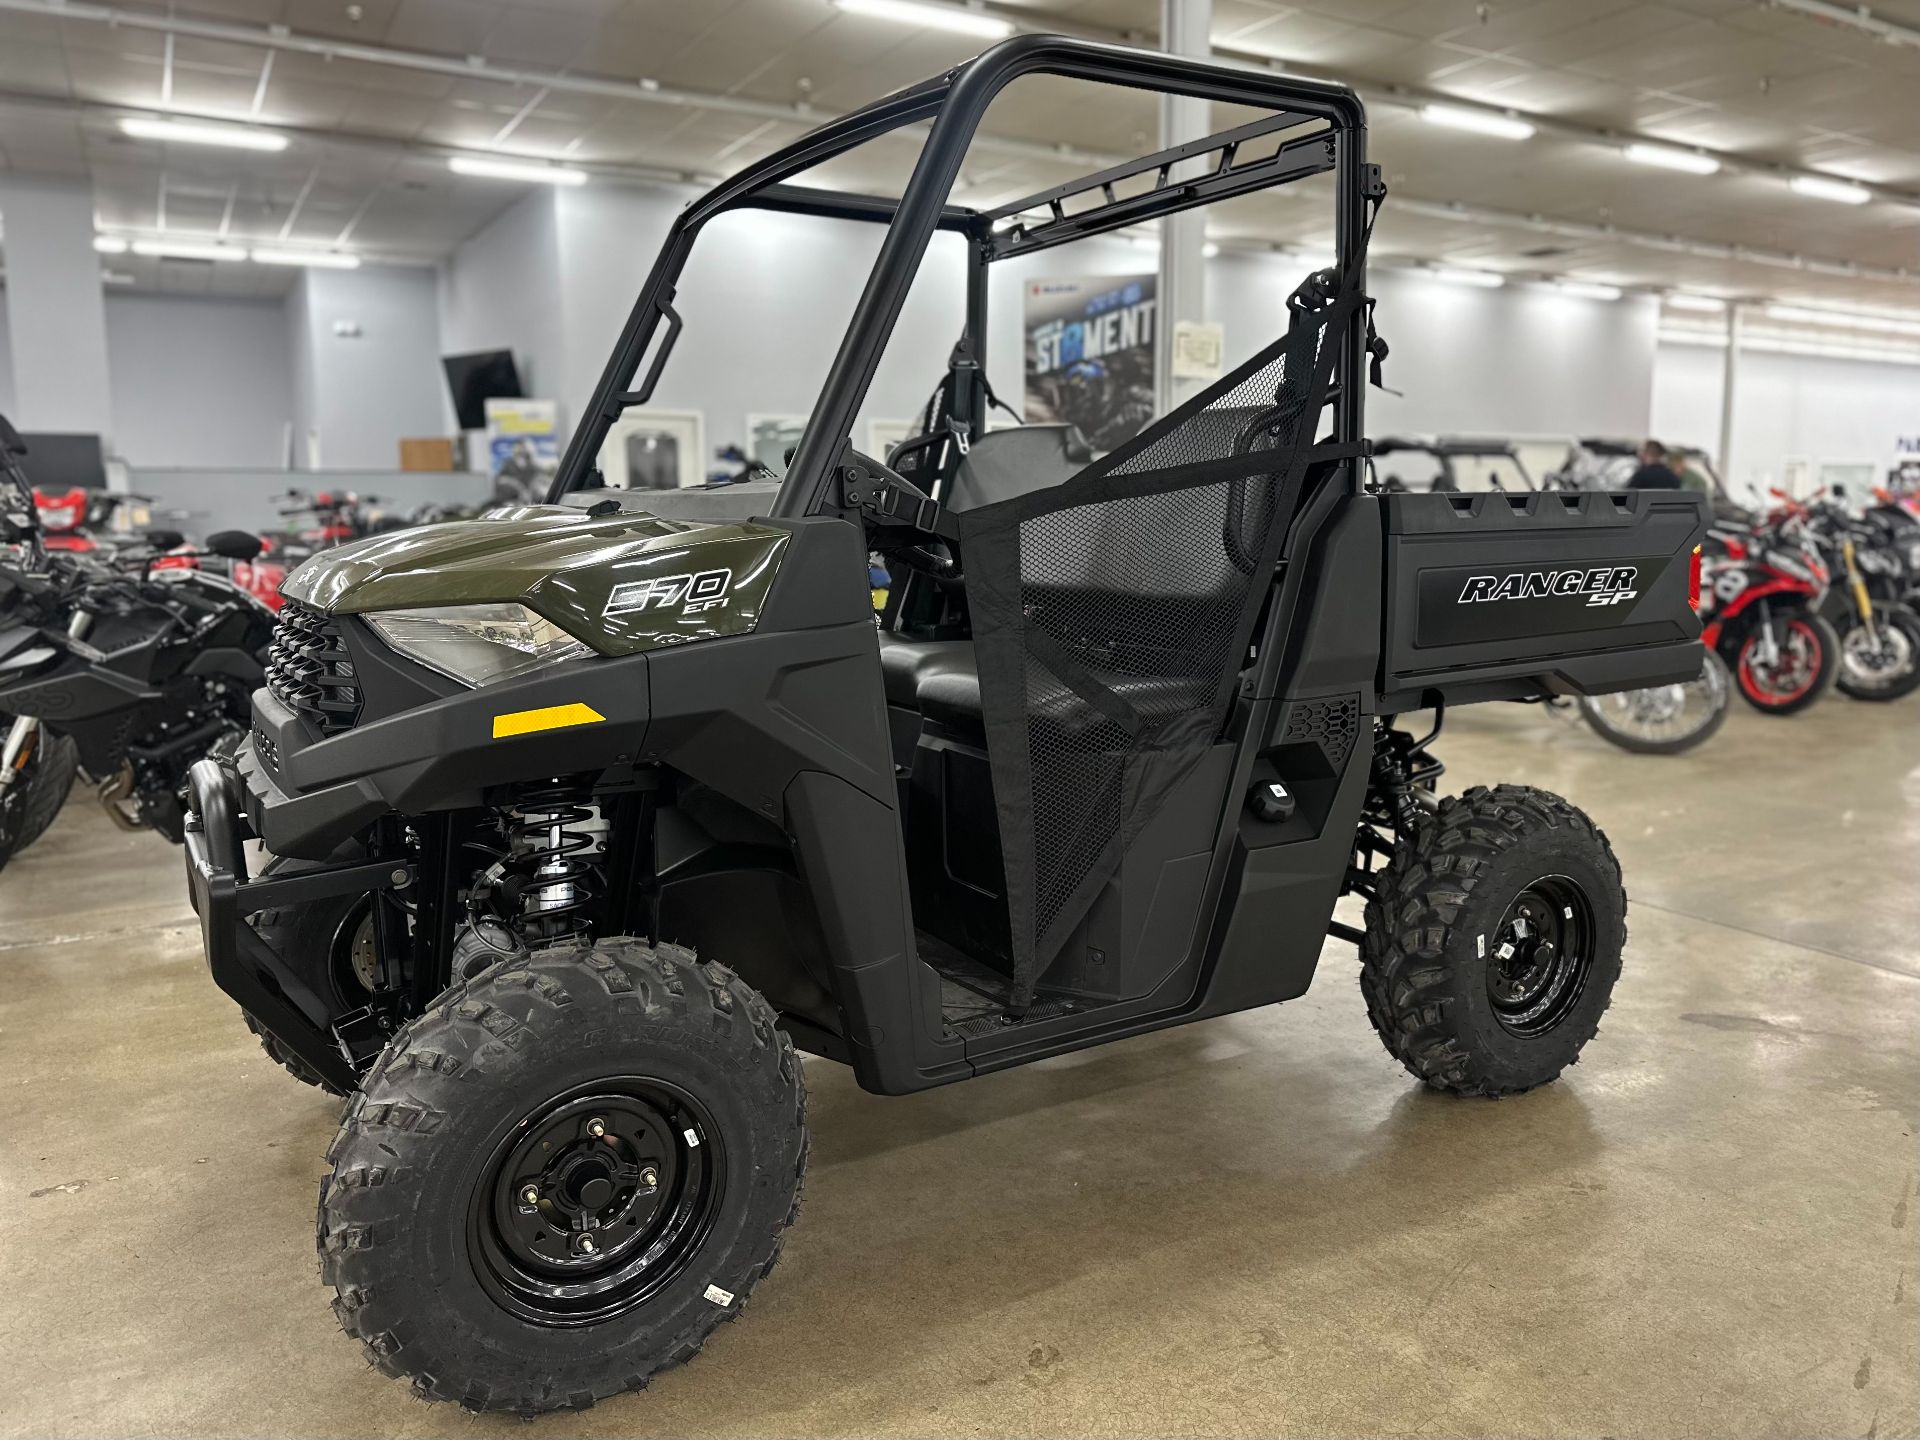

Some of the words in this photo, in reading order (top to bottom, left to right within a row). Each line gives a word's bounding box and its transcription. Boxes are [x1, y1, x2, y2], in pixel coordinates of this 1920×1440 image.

[601, 568, 732, 616] 570
[1457, 566, 1637, 603] RANGER
[1585, 590, 1638, 606] SP
[682, 597, 730, 615] EFI
